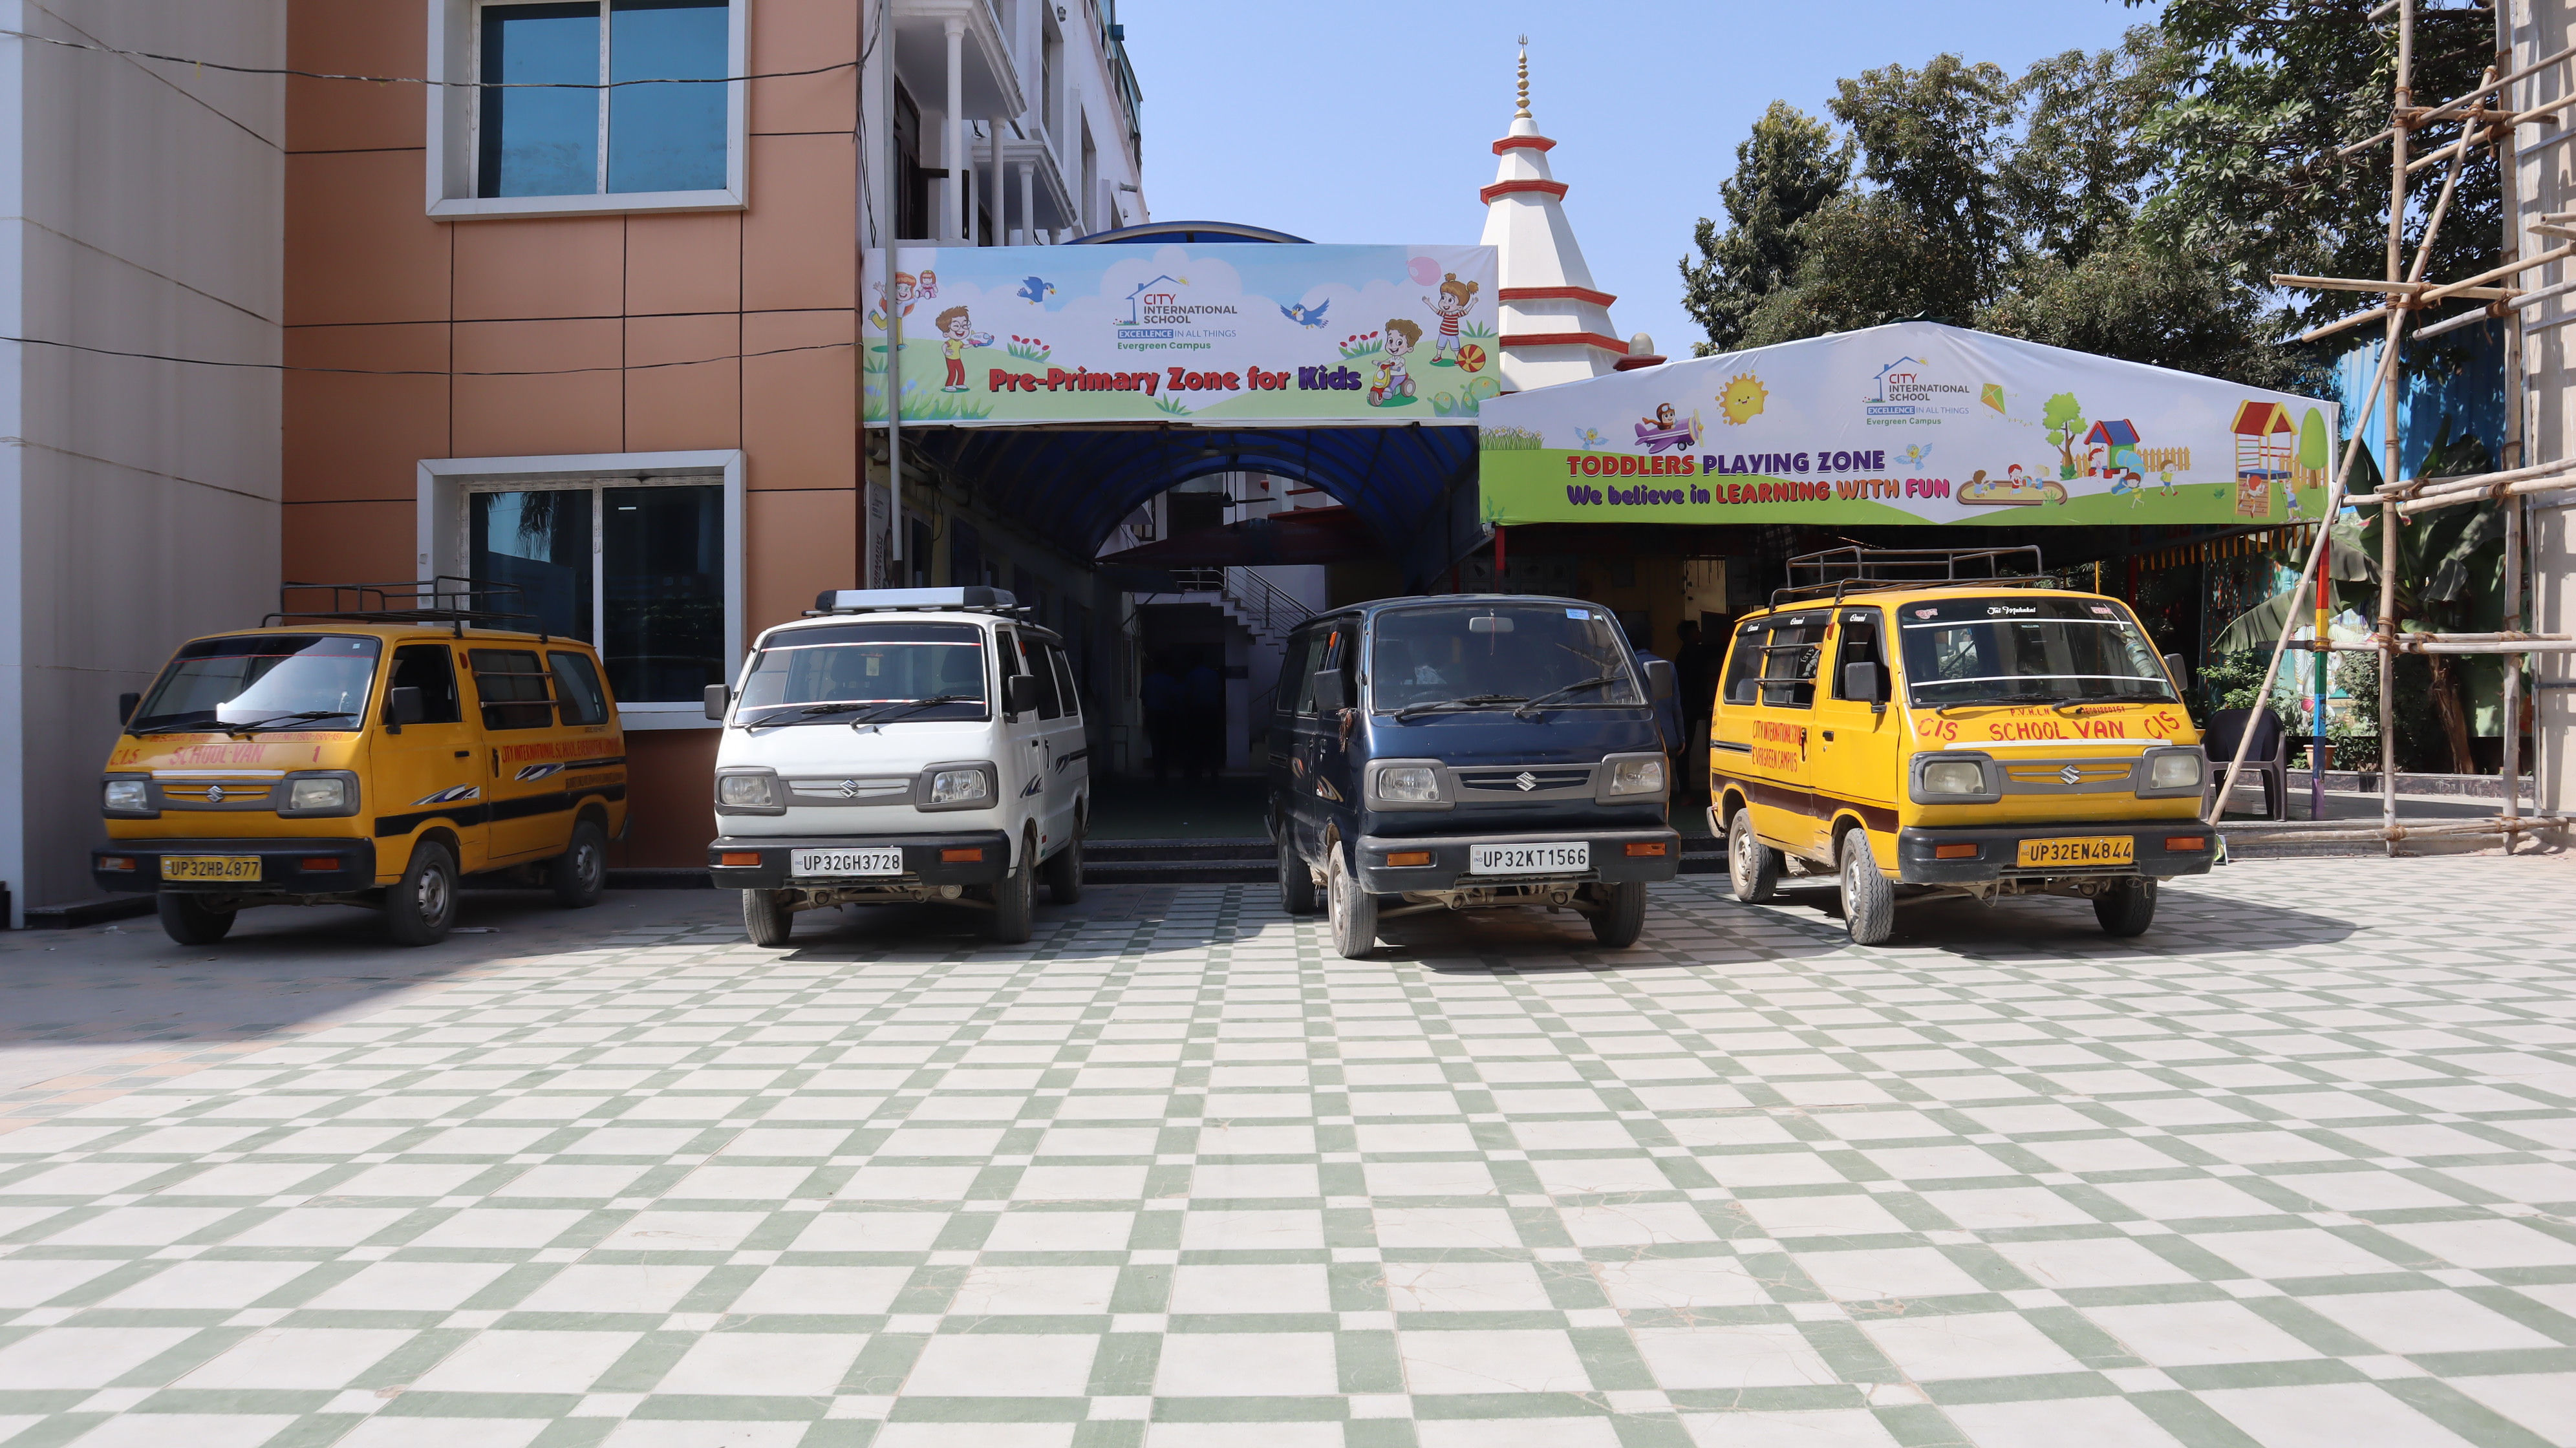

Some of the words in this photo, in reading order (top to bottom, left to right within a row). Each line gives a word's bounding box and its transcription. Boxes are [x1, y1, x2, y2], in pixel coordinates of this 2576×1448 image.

[1144, 293, 1176, 305] CITY
[1144, 306, 1238, 314] INTERNATIONAL
[1144, 315, 1191, 324] SCHOOL
[1119, 330, 1172, 338] EXCELLENCE
[1117, 342, 1167, 352] Evergreen
[1170, 342, 1211, 352] Campus
[989, 365, 1160, 396] Pre-Primary
[1166, 367, 1240, 390] Zone
[1247, 366, 1291, 390] for
[1298, 364, 1362, 391] Kids
[1889, 373, 1917, 384] CITY
[1889, 385, 1970, 393] INTERNATIONAL
[1889, 393, 1930, 401] SCHOOL
[1867, 418, 1907, 427] Evergreen
[1909, 418, 1942, 426] Campus
[1566, 454, 1695, 477] TODDLERS
[1702, 452, 1809, 476] PLAYING
[1817, 451, 1885, 473] ZONE
[1566, 485, 1602, 506] We
[1608, 484, 1684, 506] believe
[1690, 484, 1710, 504] in
[1716, 481, 1830, 504] LEARNING
[1836, 478, 1899, 500] WITH
[1905, 478, 1950, 499] FUN
[2002, 606, 2036, 615] Mahakal
[1752, 720, 1763, 740] CITY
[1918, 718, 1958, 741] CIS
[1989, 720, 2069, 741] SCHOOL
[2072, 720, 2125, 739] VAN
[2144, 711, 2180, 740] CIS
[1752, 747, 1777, 769] EVERGREEN
[1777, 751, 1798, 772] CAMPUS
[1484, 849, 1586, 868] UP32KT1566
[2030, 842, 2131, 861] UP32EN4844
[171, 861, 259, 876] UP32HB4877
[804, 854, 900, 871] UP32GH3728
